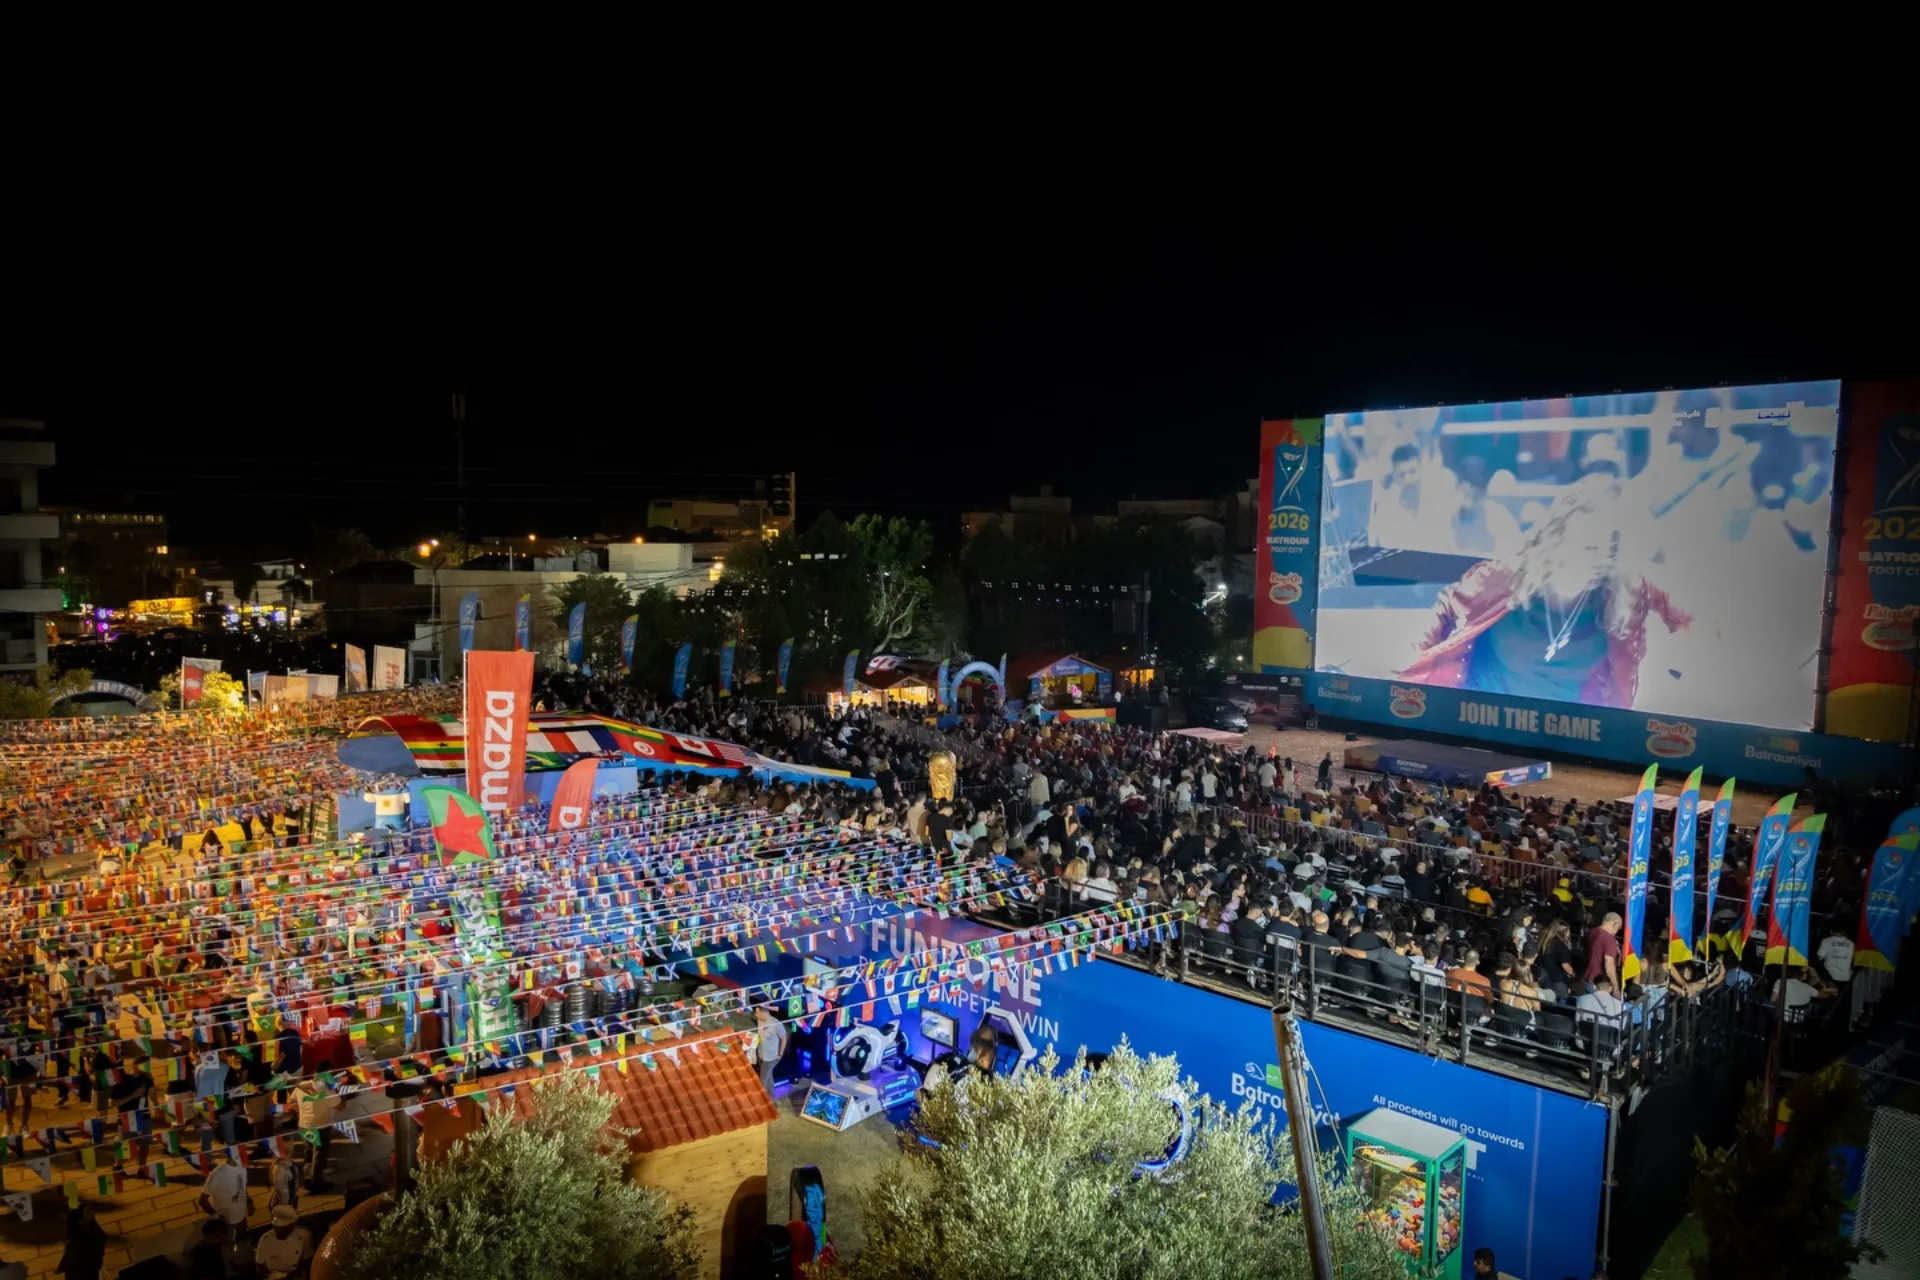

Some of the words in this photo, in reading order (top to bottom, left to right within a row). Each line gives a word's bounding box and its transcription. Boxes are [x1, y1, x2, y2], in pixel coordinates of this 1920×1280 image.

[1268, 513, 1310, 531] 2026
[1266, 536, 1309, 545] BATROUN
[1858, 551, 1920, 562] BATRO
[1868, 566, 1903, 576] FOOT
[97, 681, 125, 693] FOOT
[1459, 701, 1499, 727] JOIN
[1504, 707, 1539, 733] THE
[1544, 713, 1601, 742] GAME
[1017, 1009, 1059, 1042] WIN
[1373, 1094, 1386, 1106] All
[1387, 1099, 1437, 1122] proceeds
[1440, 1116, 1458, 1129] will
[1460, 1123, 1475, 1135] go
[1477, 1127, 1525, 1151] towards
